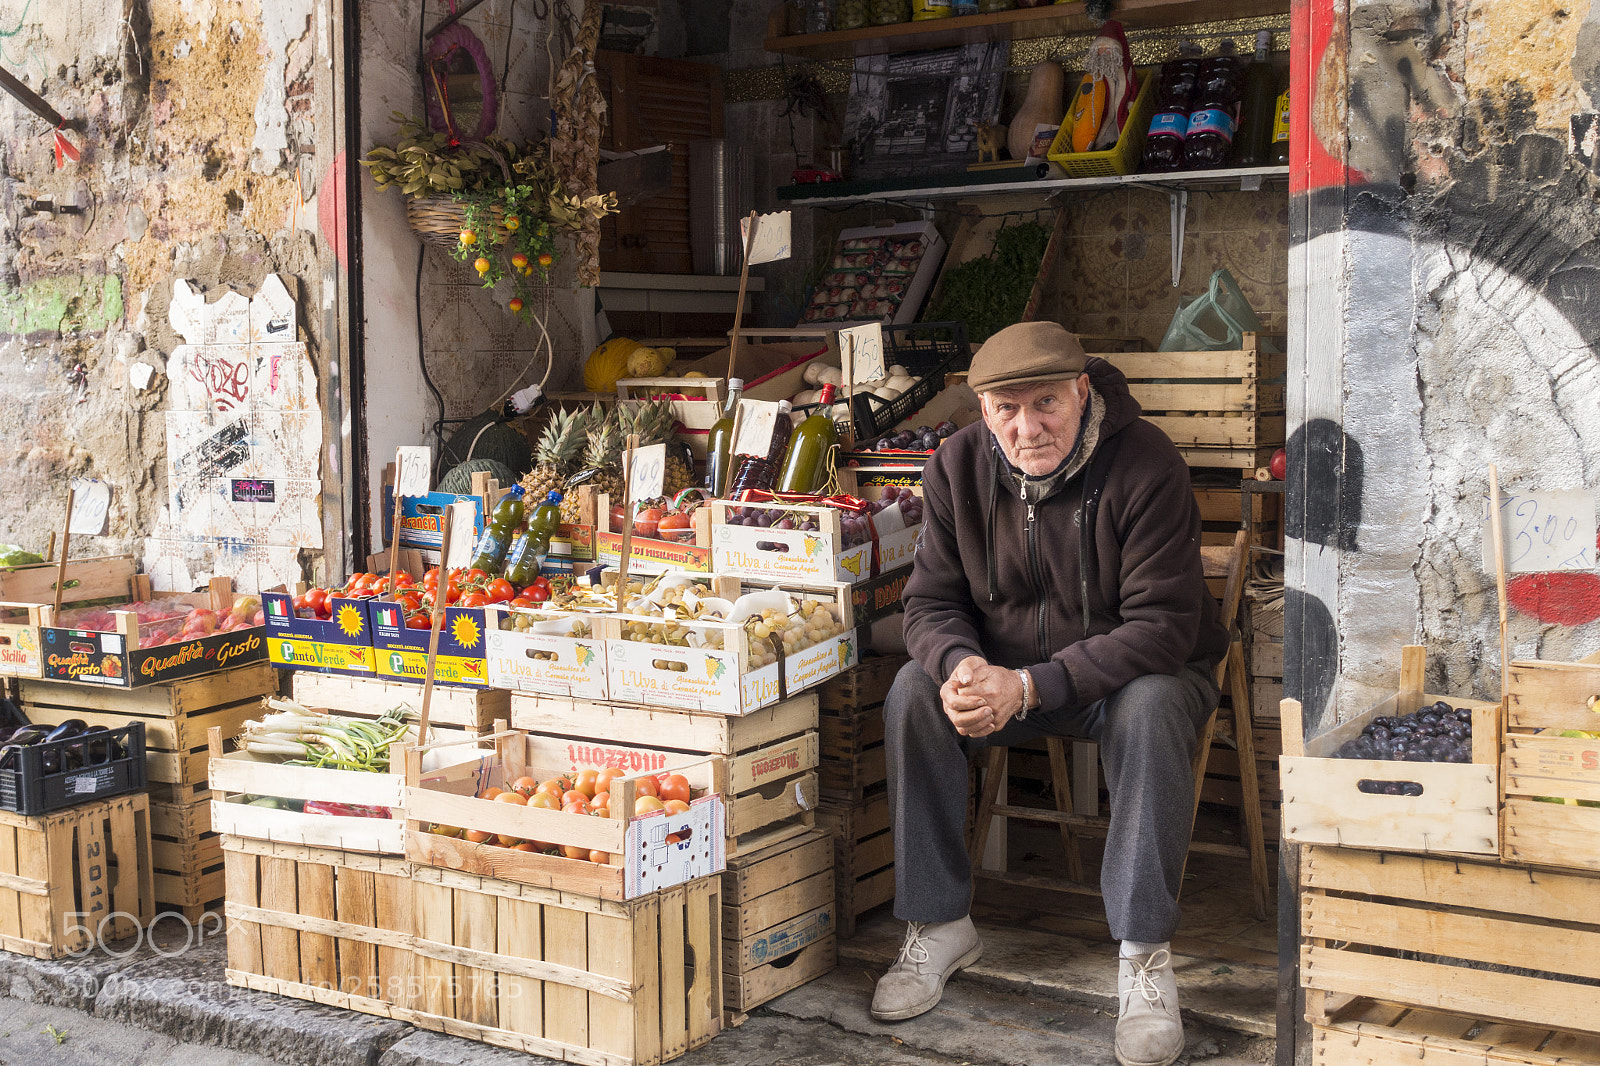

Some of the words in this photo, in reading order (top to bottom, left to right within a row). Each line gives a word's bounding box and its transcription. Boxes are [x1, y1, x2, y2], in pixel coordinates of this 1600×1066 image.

[634, 546, 644, 556] DI
[645, 547, 688, 564] MISILMERI
[725, 551, 761, 569] L'Uva
[763, 559, 771, 570] di
[1, 649, 27, 664] Sicilia
[48, 653, 90, 668] Qualità
[141, 641, 204, 678] Qualità
[205, 648, 216, 660] e
[217, 634, 261, 667] Gusto
[282, 643, 316, 663] Punto
[311, 643, 346, 666] Verde
[391, 654, 427, 675] Punto
[58, 667, 67, 675] e
[68, 663, 101, 679] Gusto
[498, 657, 533, 677] L'Uva
[535, 669, 543, 678] di
[620, 669, 659, 690] L'Uva
[661, 680, 669, 691] di
[742, 677, 780, 708] L'Uva
